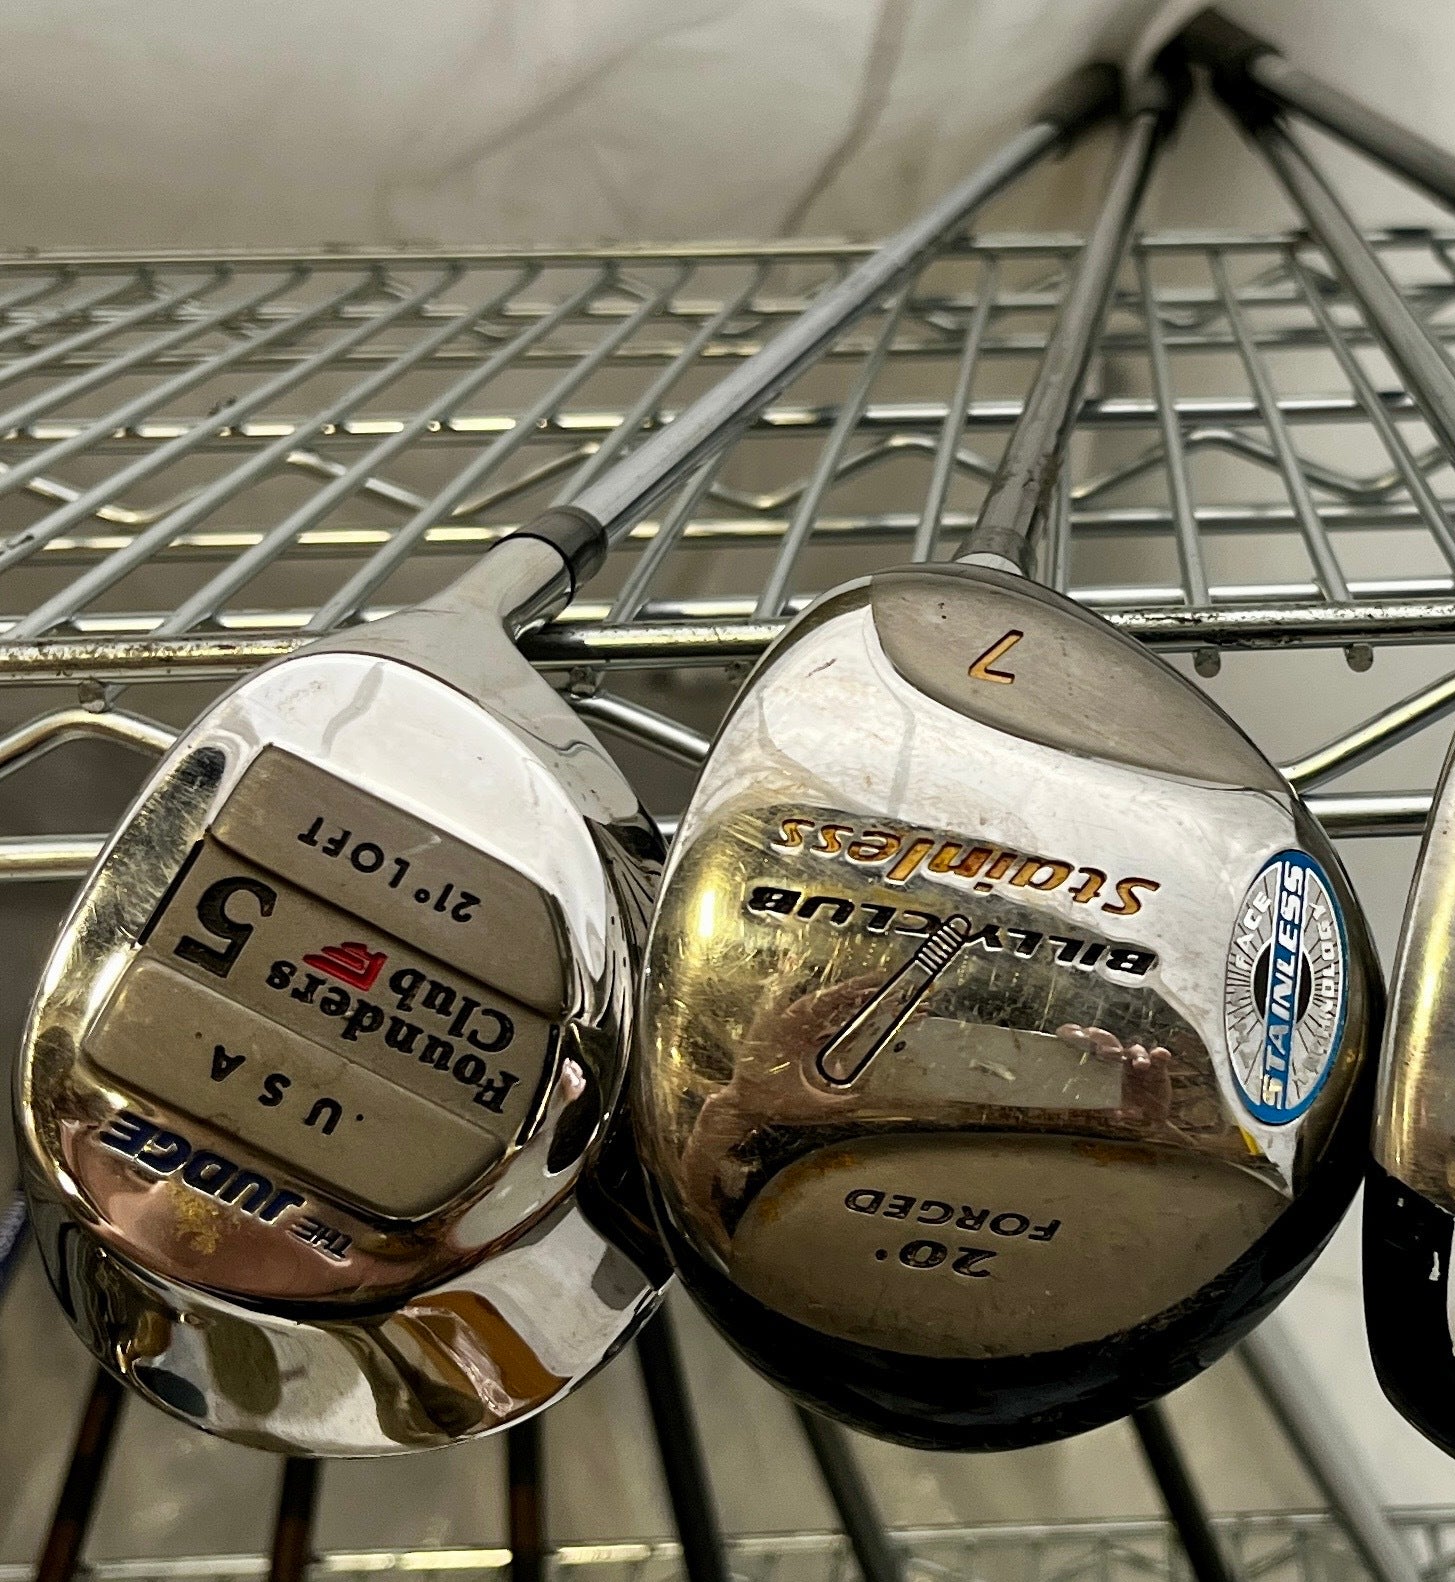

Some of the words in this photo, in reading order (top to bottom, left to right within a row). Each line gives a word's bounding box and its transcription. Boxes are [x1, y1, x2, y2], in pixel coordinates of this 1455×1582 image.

[966, 628, 1025, 686] 7
[296, 816, 410, 888] LOFT
[770, 816, 1162, 916] Stainless
[172, 875, 279, 980] 5
[747, 886, 942, 936] CLUB
[1234, 891, 1272, 970] FACE
[963, 923, 1159, 979] BILLY
[1260, 860, 1305, 1110] STAINLESS
[264, 960, 520, 1113] Founders
[388, 967, 515, 1053] Club
[98, 1108, 307, 1226] JUDGE
[290, 1216, 353, 1260] THE
[844, 1188, 1062, 1243] FORGED
